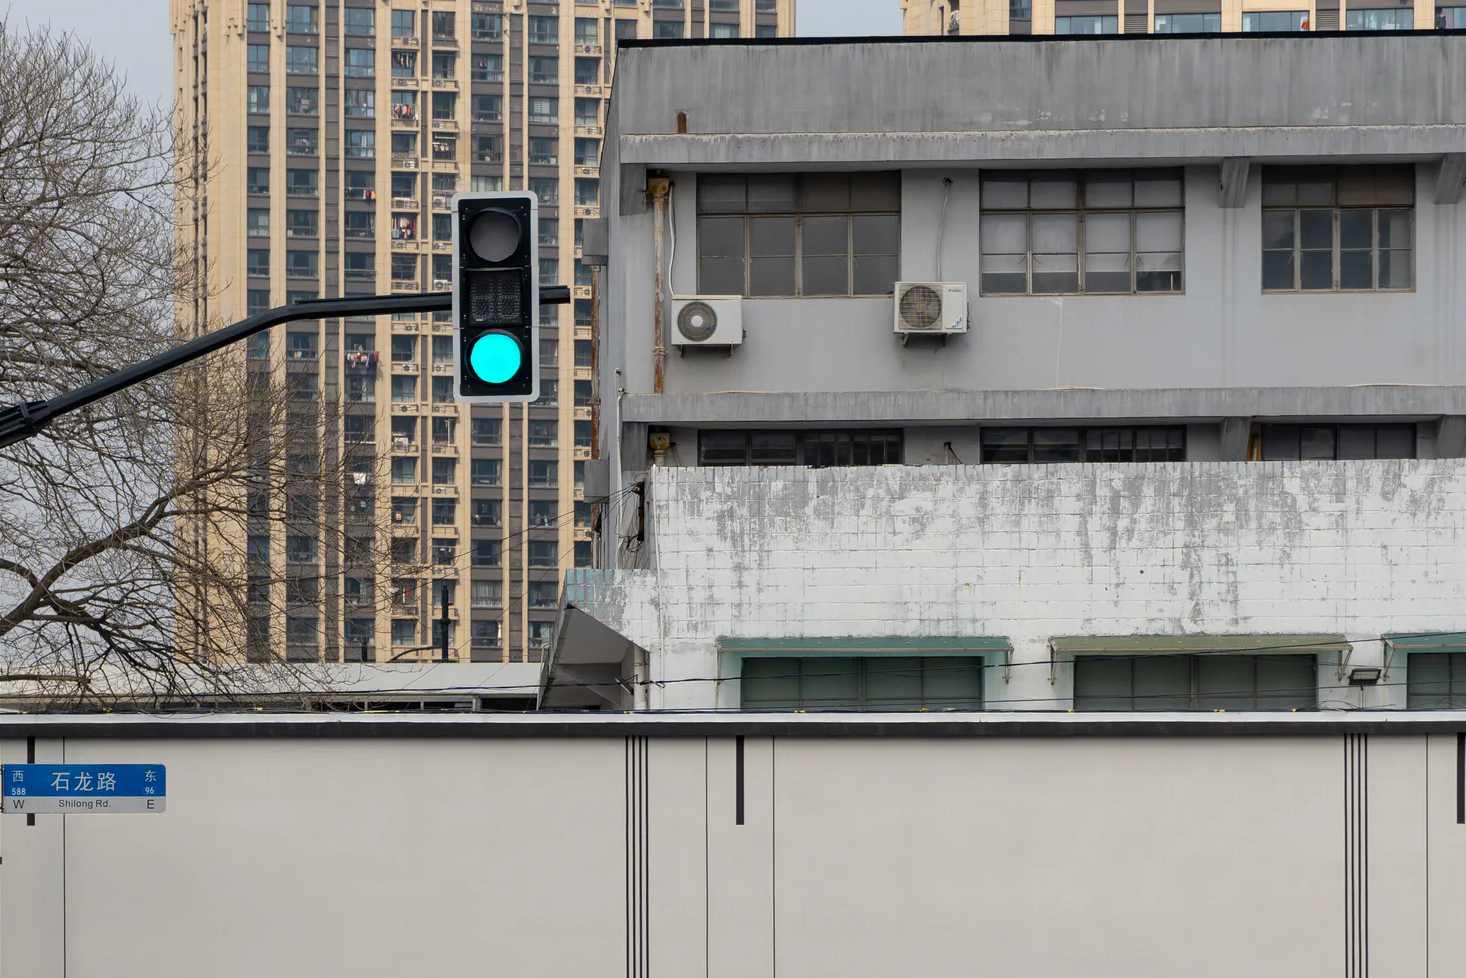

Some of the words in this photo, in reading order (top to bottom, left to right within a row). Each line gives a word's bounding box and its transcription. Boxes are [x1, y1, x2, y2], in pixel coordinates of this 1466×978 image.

[12, 770, 24, 783] 西
[50, 771, 117, 791] 石龙路
[144, 769, 157, 783] 东
[11, 787, 26, 796] 588
[144, 786, 155, 795] 96
[13, 799, 25, 810] W
[58, 799, 93, 810] Shilong
[95, 799, 112, 808] Rd.
[146, 799, 155, 810] E
